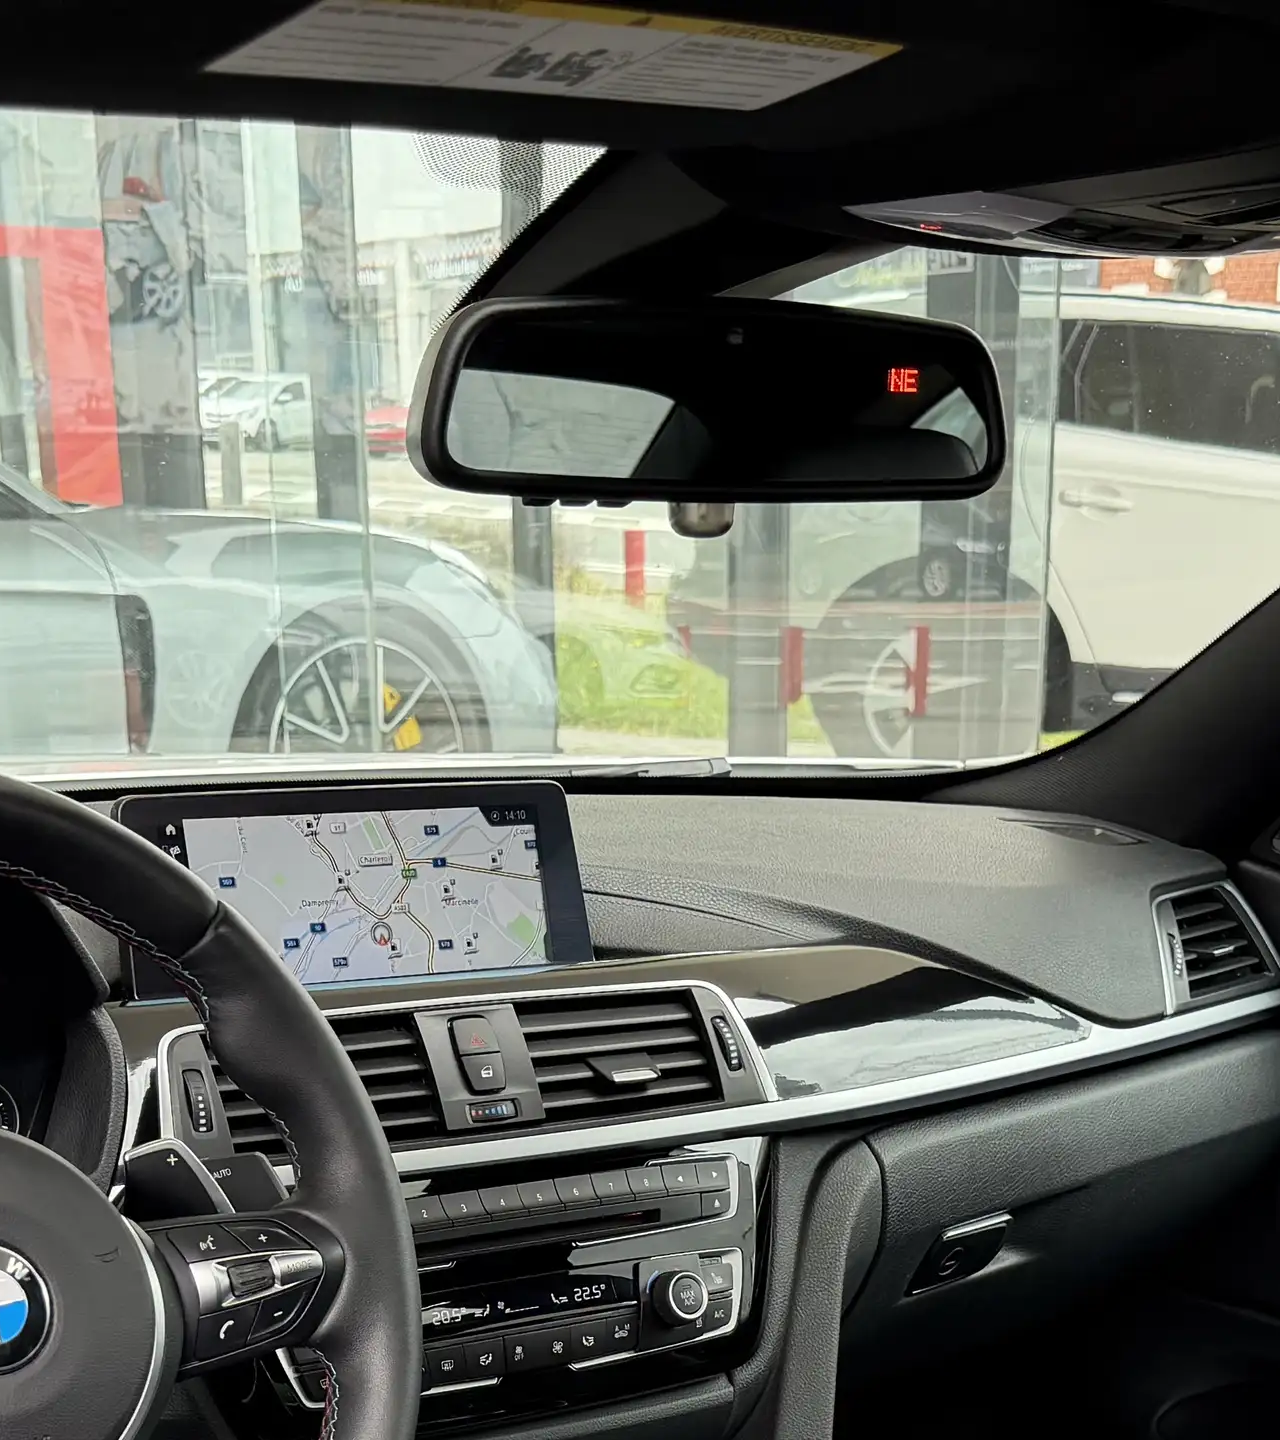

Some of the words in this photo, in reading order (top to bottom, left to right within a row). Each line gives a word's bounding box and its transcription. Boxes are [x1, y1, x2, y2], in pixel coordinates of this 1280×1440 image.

[890, 368, 918, 392] NE
[504, 810, 526, 821] 14:10
[213, 1168, 232, 1179] AUTO
[607, 1182, 614, 1192] 7
[643, 1178, 650, 1187] 8
[572, 1187, 579, 1196] 6
[536, 1193, 543, 1202] 5
[500, 1199, 506, 1207] 4
[460, 1204, 468, 1213] 3
[421, 1209, 428, 1218] 2
[286, 1258, 313, 1274] MODE
[680, 1290, 696, 1300] MAX
[684, 1298, 696, 1306] A/C
[714, 1309, 725, 1319] A/C
